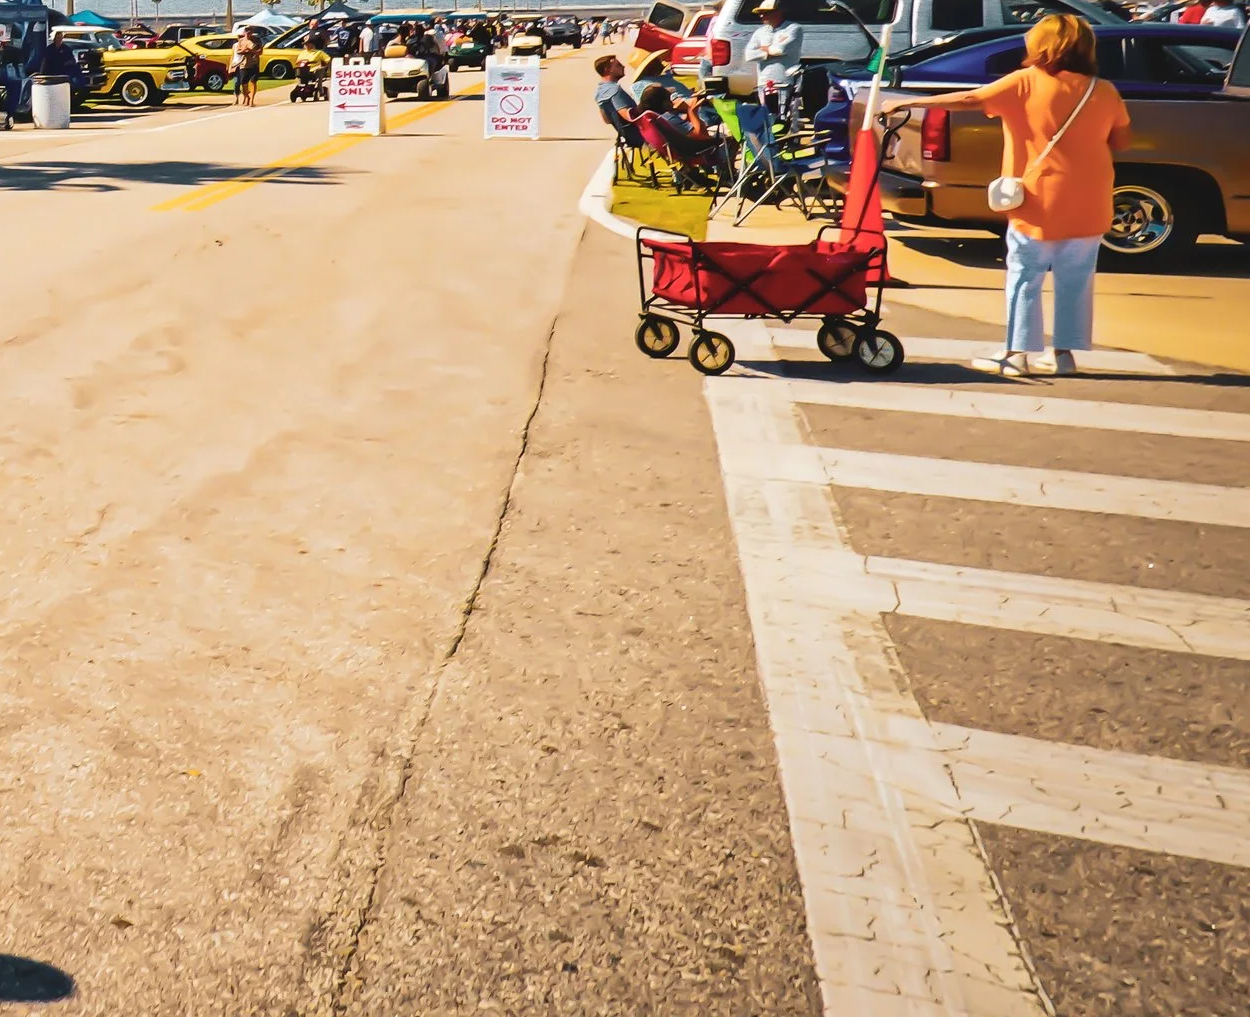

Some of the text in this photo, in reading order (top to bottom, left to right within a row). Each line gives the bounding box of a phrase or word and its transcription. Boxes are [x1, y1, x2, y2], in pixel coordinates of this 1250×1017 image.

[335, 70, 377, 79] SHOW
[338, 79, 373, 87] CARS
[338, 88, 373, 96] ONLY
